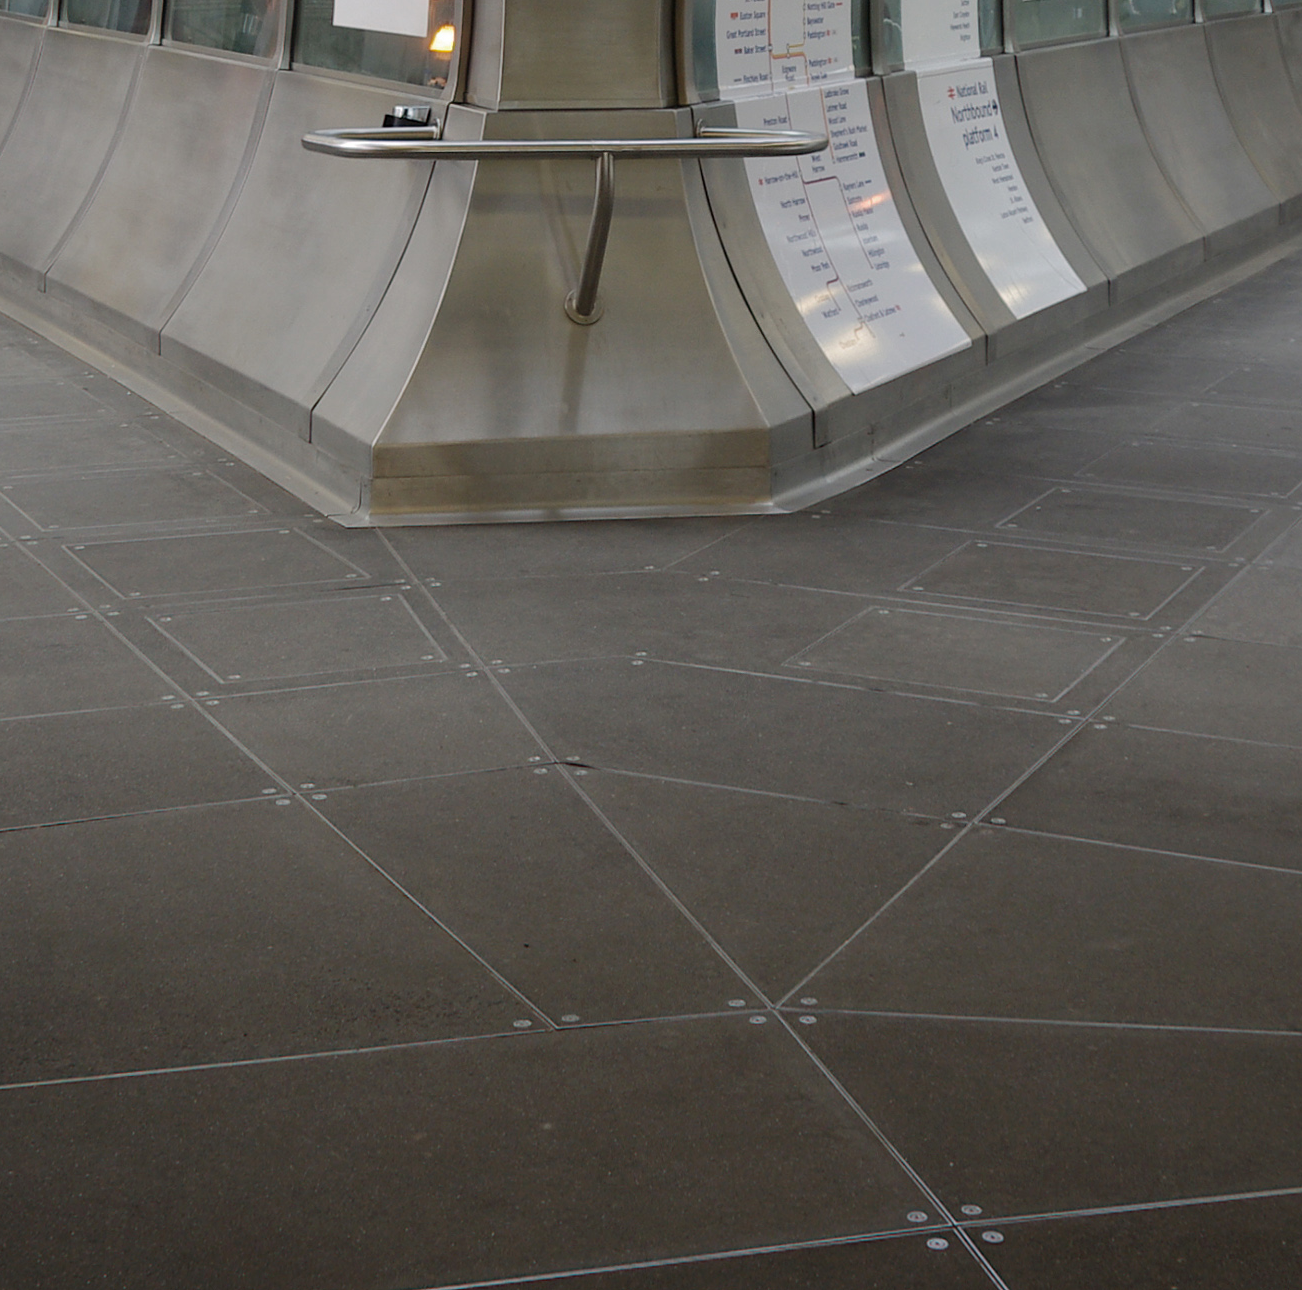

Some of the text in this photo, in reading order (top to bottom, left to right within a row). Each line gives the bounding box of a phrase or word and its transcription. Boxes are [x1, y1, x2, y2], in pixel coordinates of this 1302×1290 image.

[956, 83, 978, 99] National
[950, 100, 993, 125] Northbound
[962, 124, 999, 151] platform 4
